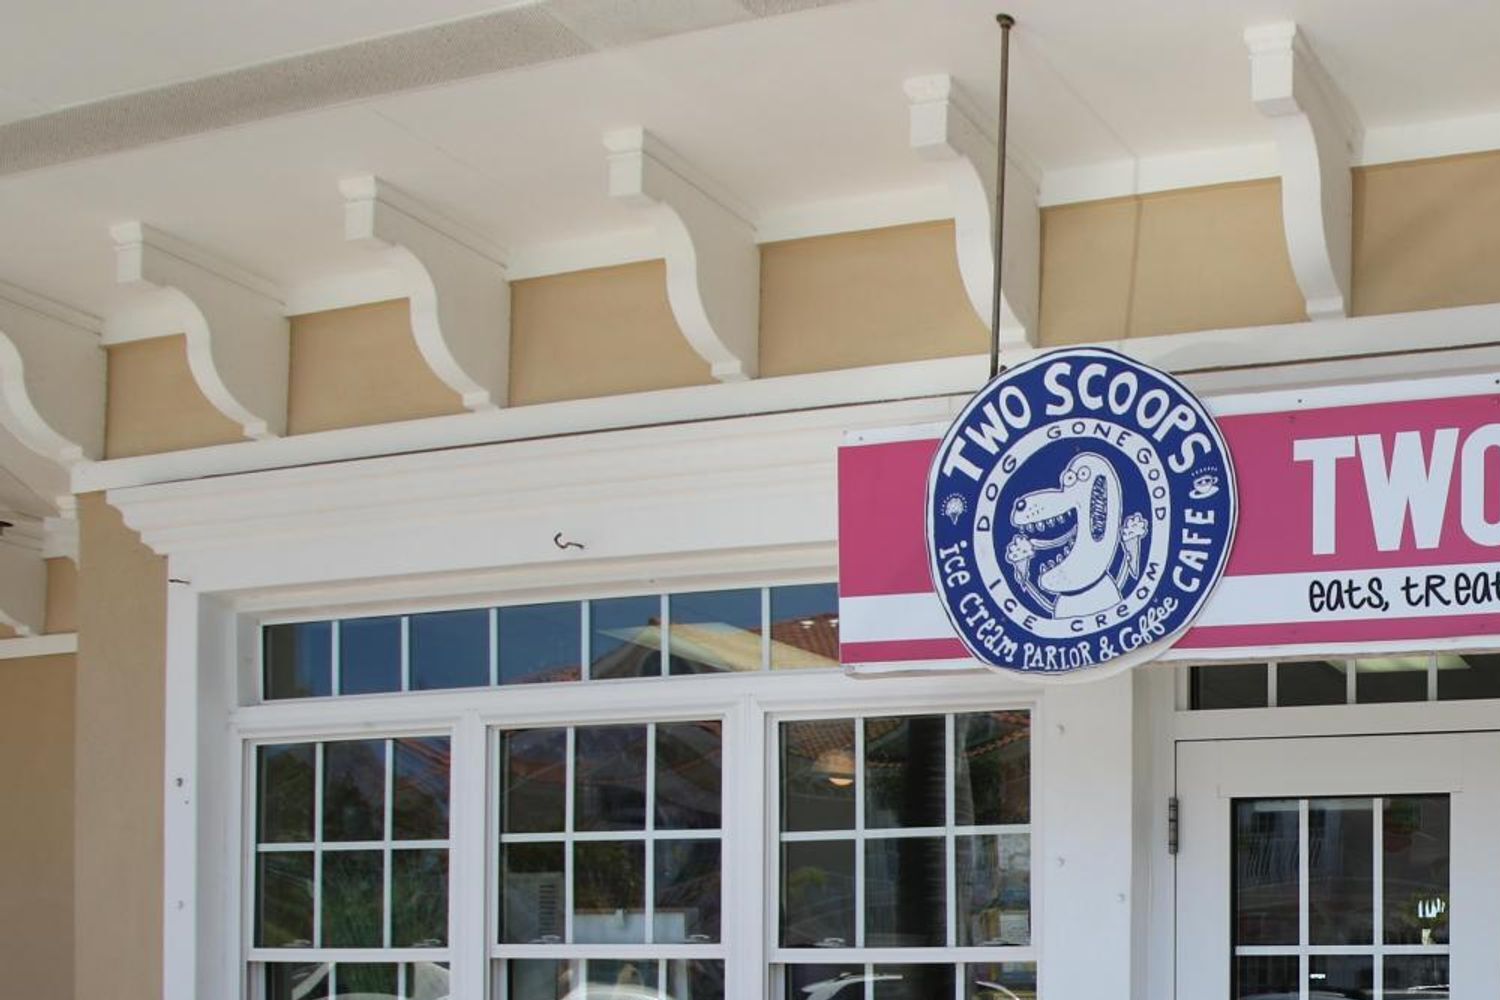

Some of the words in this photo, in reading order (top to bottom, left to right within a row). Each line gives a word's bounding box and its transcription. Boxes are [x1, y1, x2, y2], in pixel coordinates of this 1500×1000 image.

[943, 386, 1032, 481] TWO
[1043, 362, 1211, 473] SCOOPS
[976, 455, 1018, 532] DOG
[1046, 421, 1128, 448] GONE
[1136, 448, 1166, 521] GOOD
[989, 578, 1037, 630] ICE
[1021, 641, 1094, 670] PARLOR
[1100, 636, 1120, 662] &
[1172, 508, 1215, 593] CAFE
[1308, 577, 1390, 612] eats,
